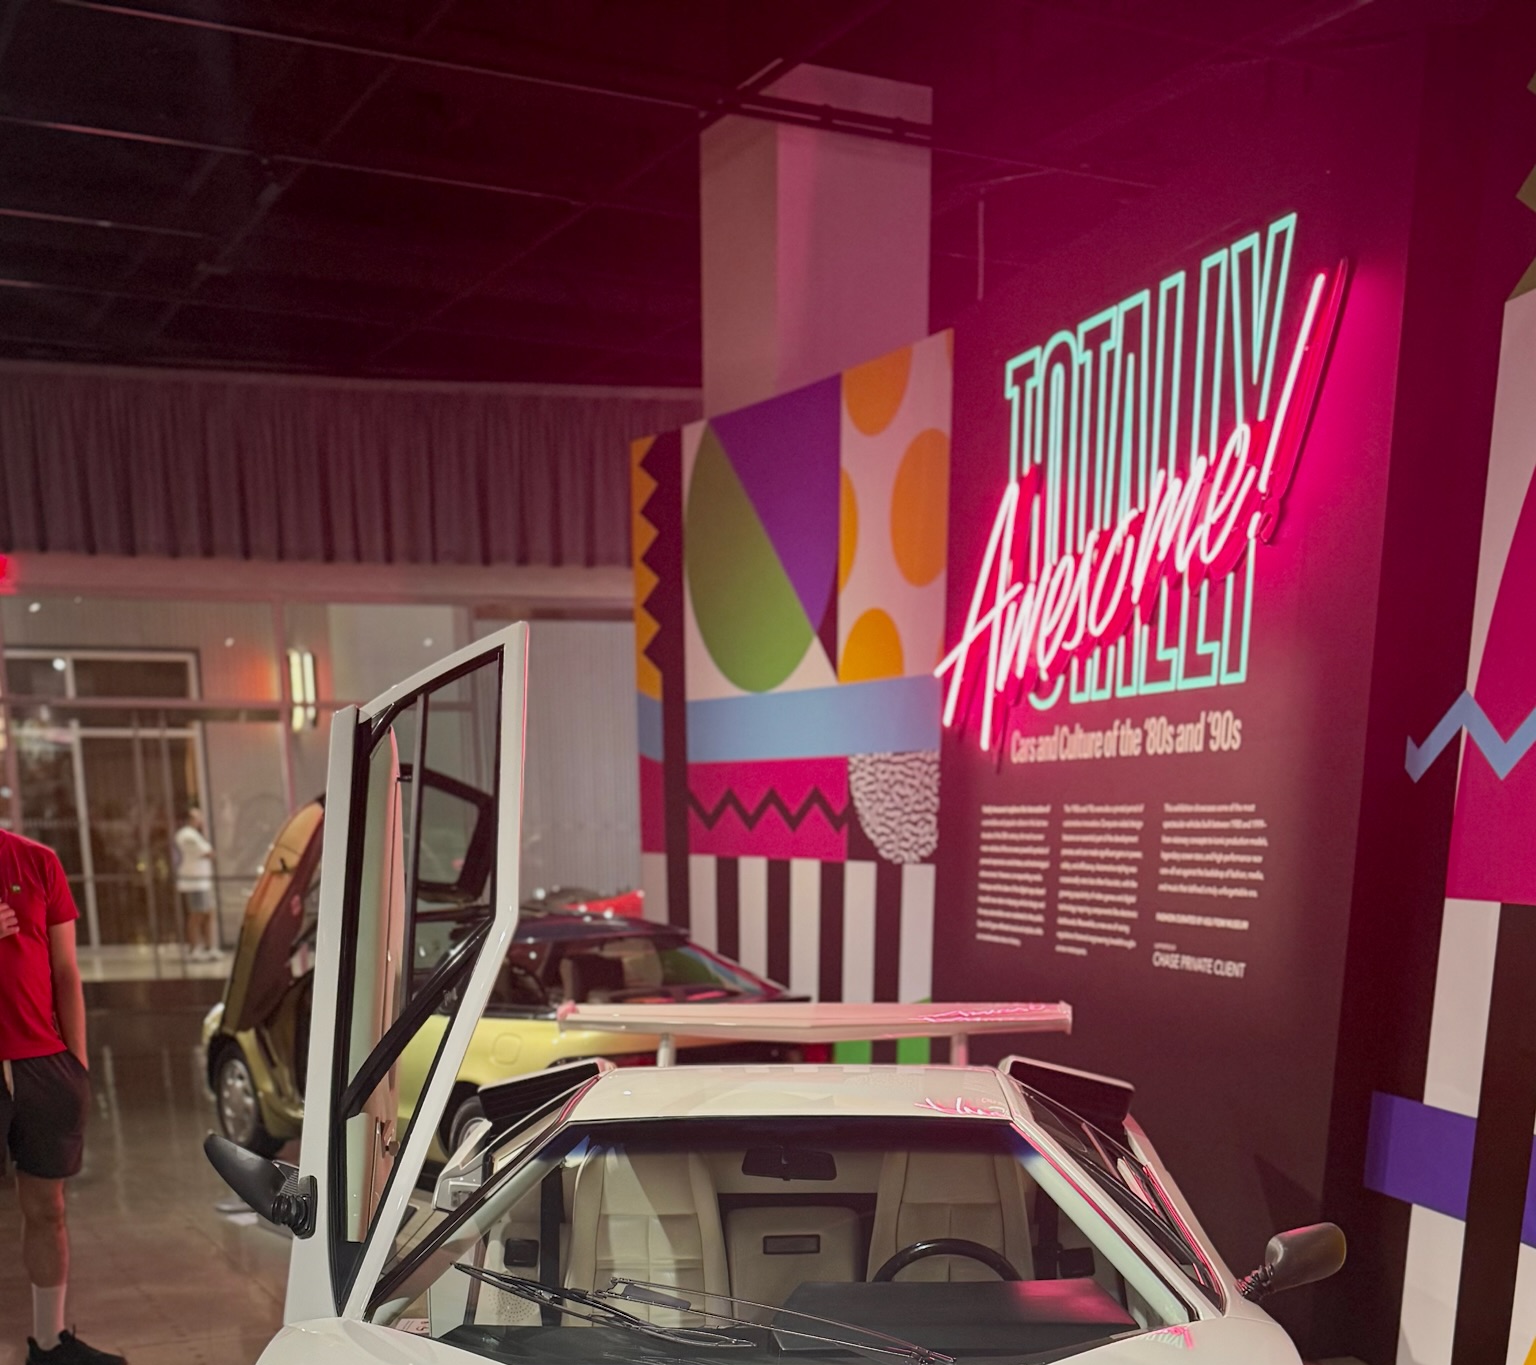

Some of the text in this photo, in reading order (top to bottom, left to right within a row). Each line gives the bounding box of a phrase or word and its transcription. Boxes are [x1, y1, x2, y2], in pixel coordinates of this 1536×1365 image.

[933, 272, 1326, 752] Awesome!
[1005, 213, 1297, 710] TOTALLY
[1010, 729, 1037, 764] Cars
[1037, 725, 1059, 762] and
[1059, 723, 1103, 761] Culture
[1103, 719, 1120, 758] of
[1120, 718, 1142, 757] the
[1175, 711, 1206, 753] and
[1152, 951, 1247, 979] CHASE PRIVATE CLIENT
